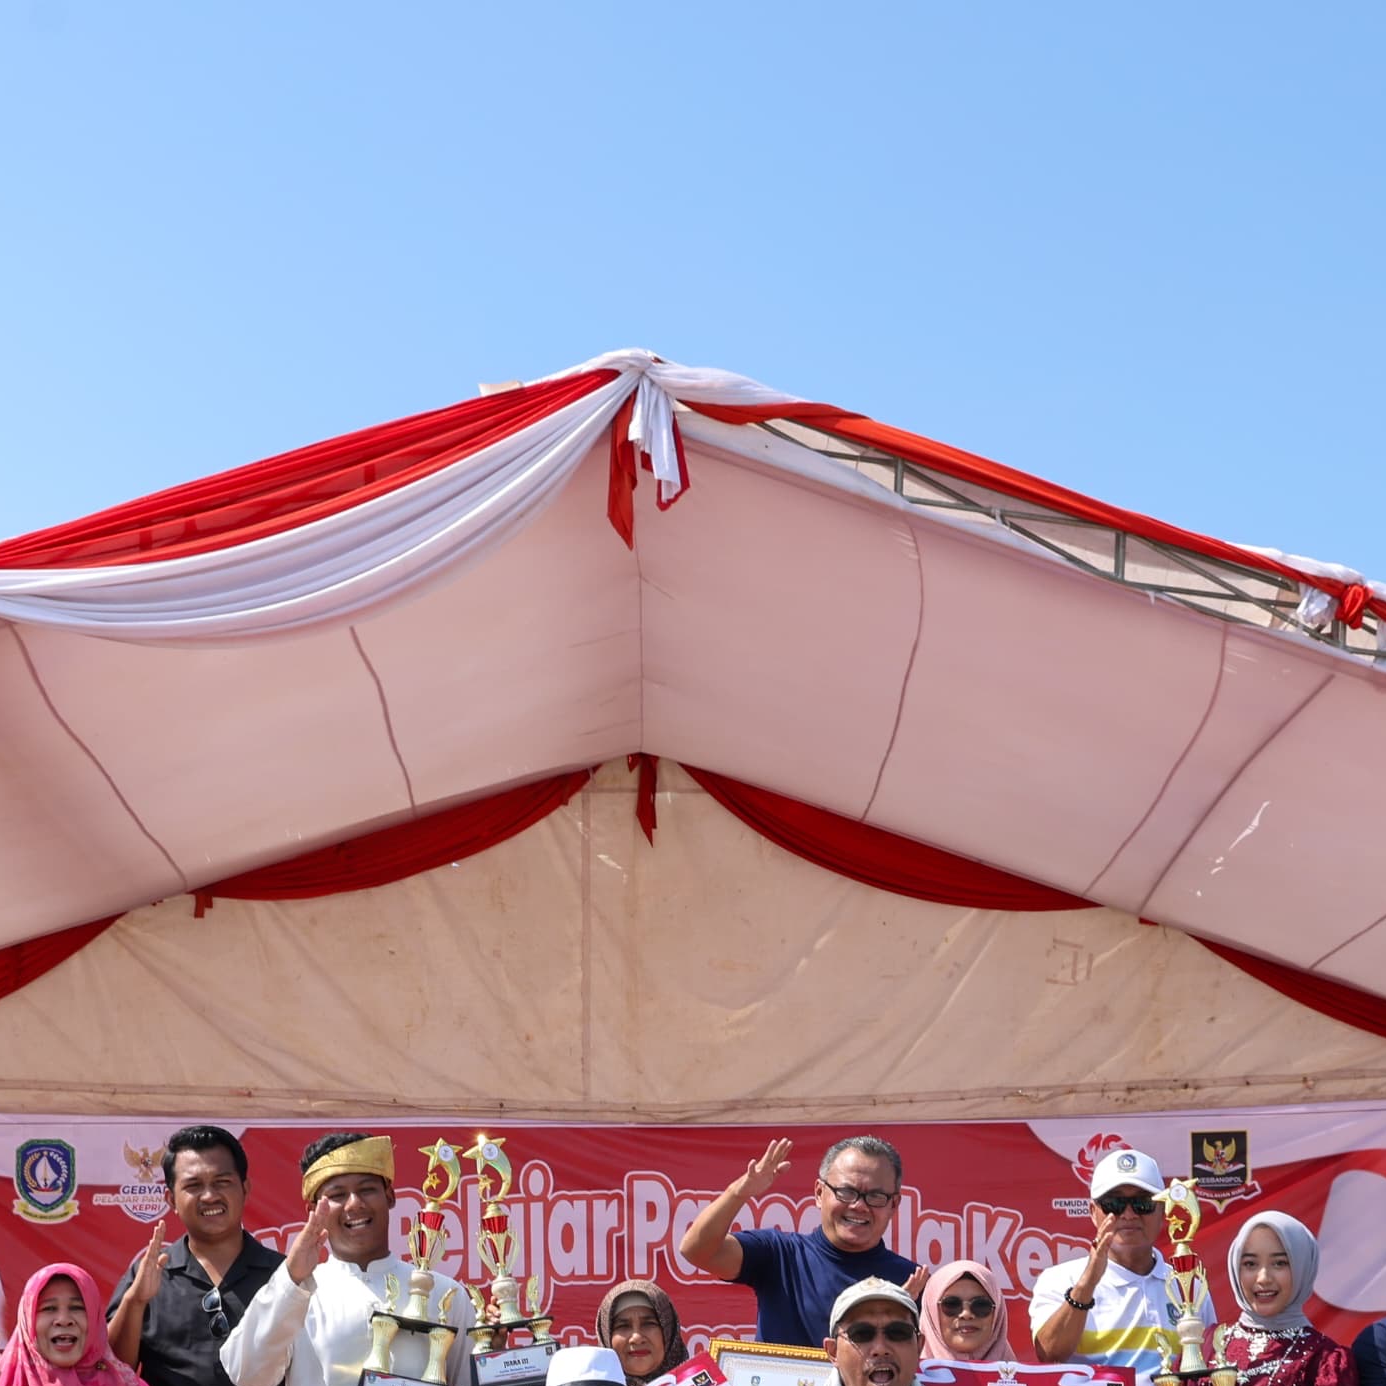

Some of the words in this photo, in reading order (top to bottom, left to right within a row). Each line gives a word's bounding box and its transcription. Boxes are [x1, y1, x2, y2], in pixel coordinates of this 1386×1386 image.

[122, 1185, 167, 1195] GEBYA
[96, 1195, 140, 1204] PELAJAR
[132, 1204, 161, 1212] KEPRI
